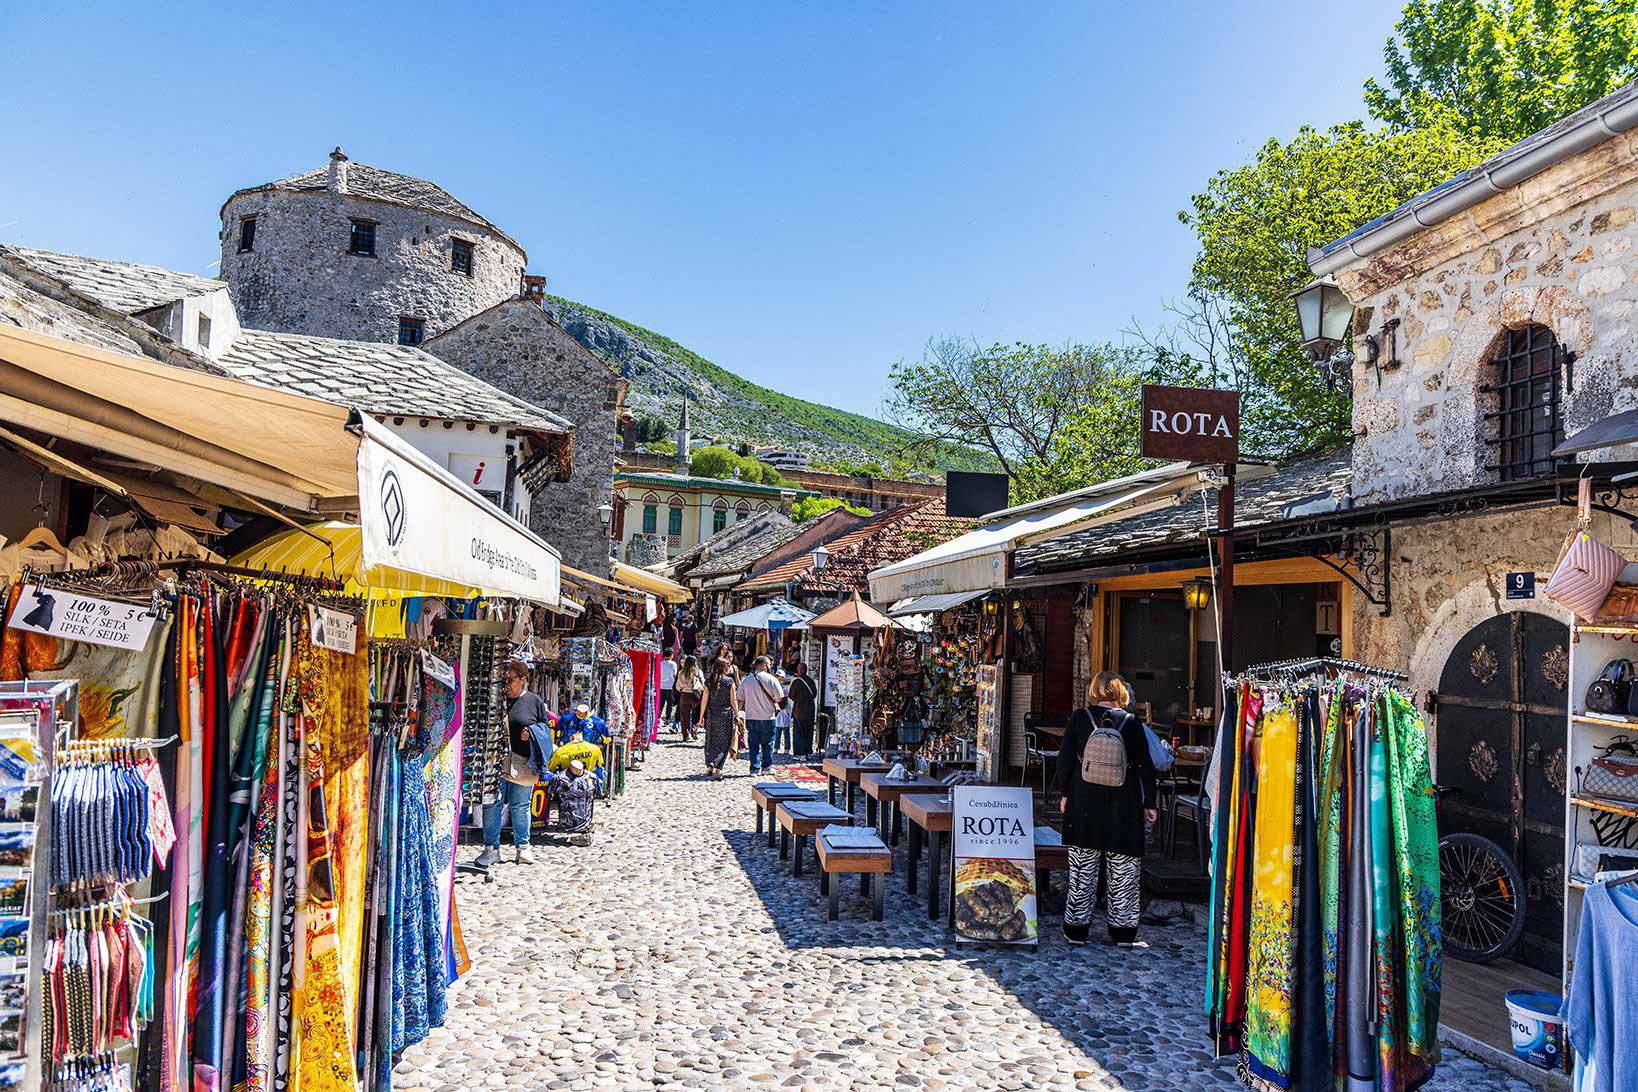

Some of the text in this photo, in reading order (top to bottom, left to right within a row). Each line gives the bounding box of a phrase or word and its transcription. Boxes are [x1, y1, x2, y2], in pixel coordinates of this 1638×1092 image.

[1149, 409, 1233, 438] ROTA
[1516, 574, 1525, 589] 9
[69, 599, 96, 613] 100
[98, 604, 111, 617] %
[64, 611, 92, 624] SILK
[99, 617, 127, 630] SETA
[59, 622, 88, 636] IPEK
[95, 629, 130, 643] SEIDE
[961, 816, 1027, 837] ROTA
